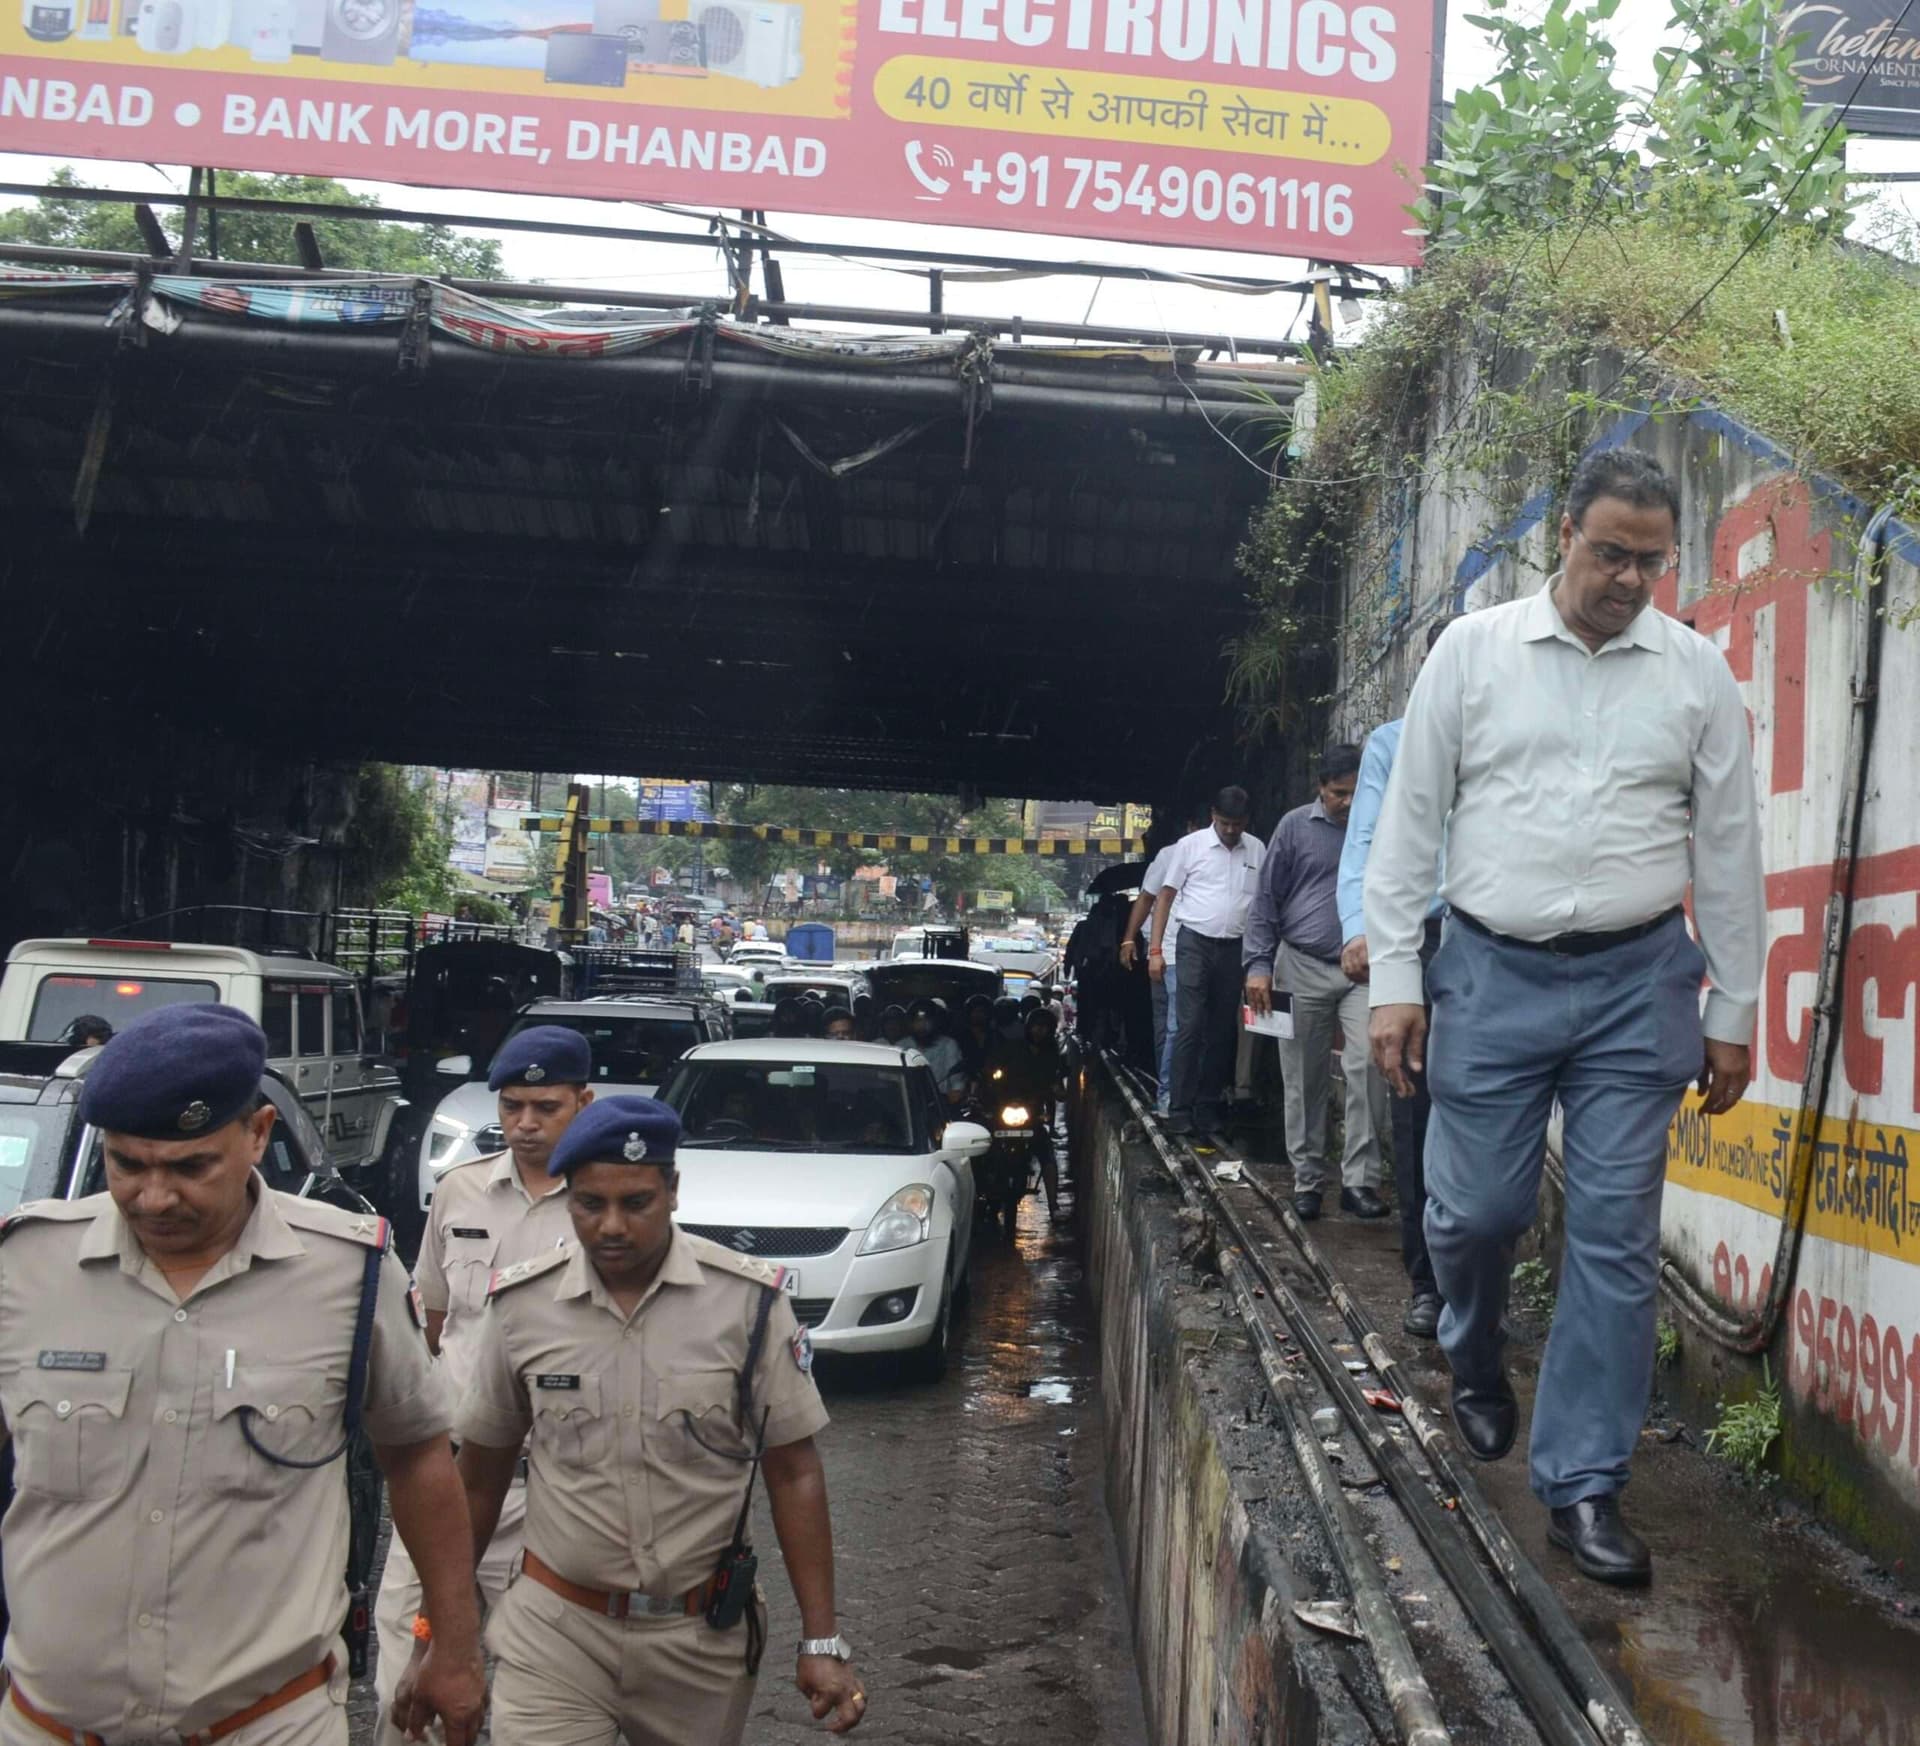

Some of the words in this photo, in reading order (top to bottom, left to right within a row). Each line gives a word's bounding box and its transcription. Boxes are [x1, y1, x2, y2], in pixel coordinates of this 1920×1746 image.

[0, 75, 154, 127] NBAD
[222, 94, 373, 144] BANK
[384, 107, 552, 165] MORE,
[566, 120, 827, 178] DHANBAD
[905, 75, 951, 110] 40
[1041, 76, 1074, 119] से
[1087, 89, 1208, 132] आपकी
[1221, 94, 1290, 140] सेवा
[963, 151, 1049, 207] +91
[1063, 158, 1354, 237] 7549061116
